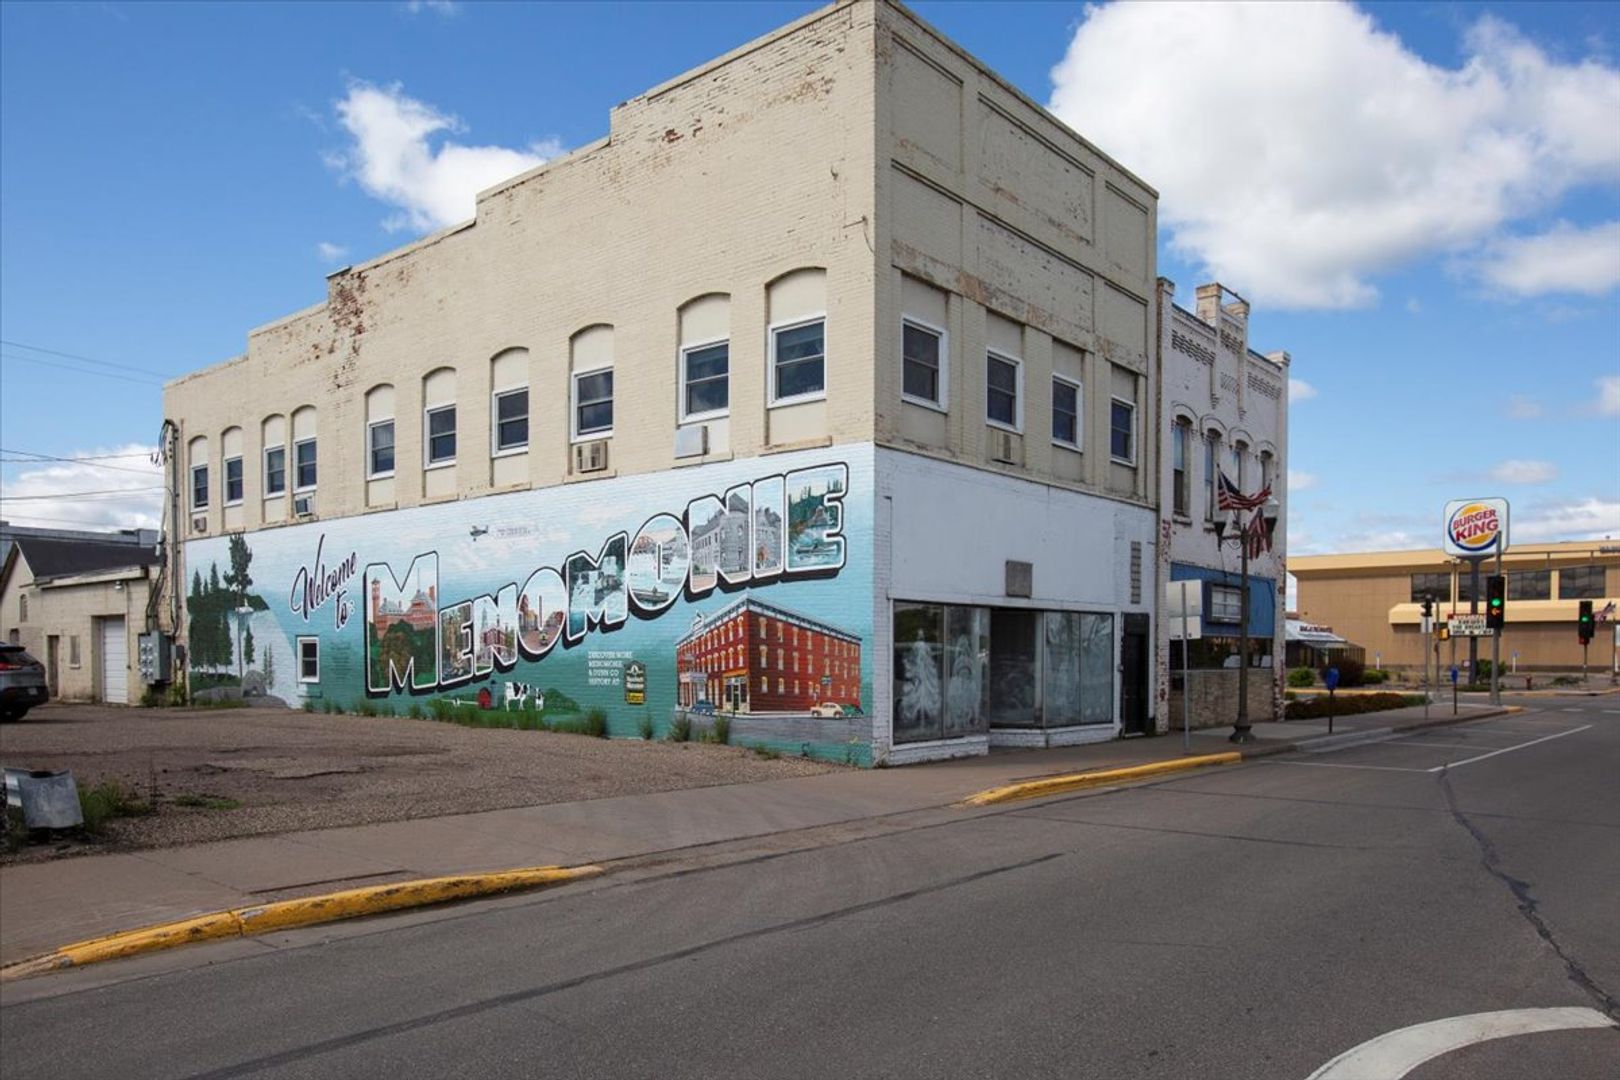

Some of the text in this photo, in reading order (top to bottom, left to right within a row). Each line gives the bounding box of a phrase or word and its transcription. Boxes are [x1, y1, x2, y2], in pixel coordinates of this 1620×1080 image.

[1453, 509, 1497, 530] BURGER
[1455, 519, 1499, 542] KING
[289, 533, 357, 621] Welcome
